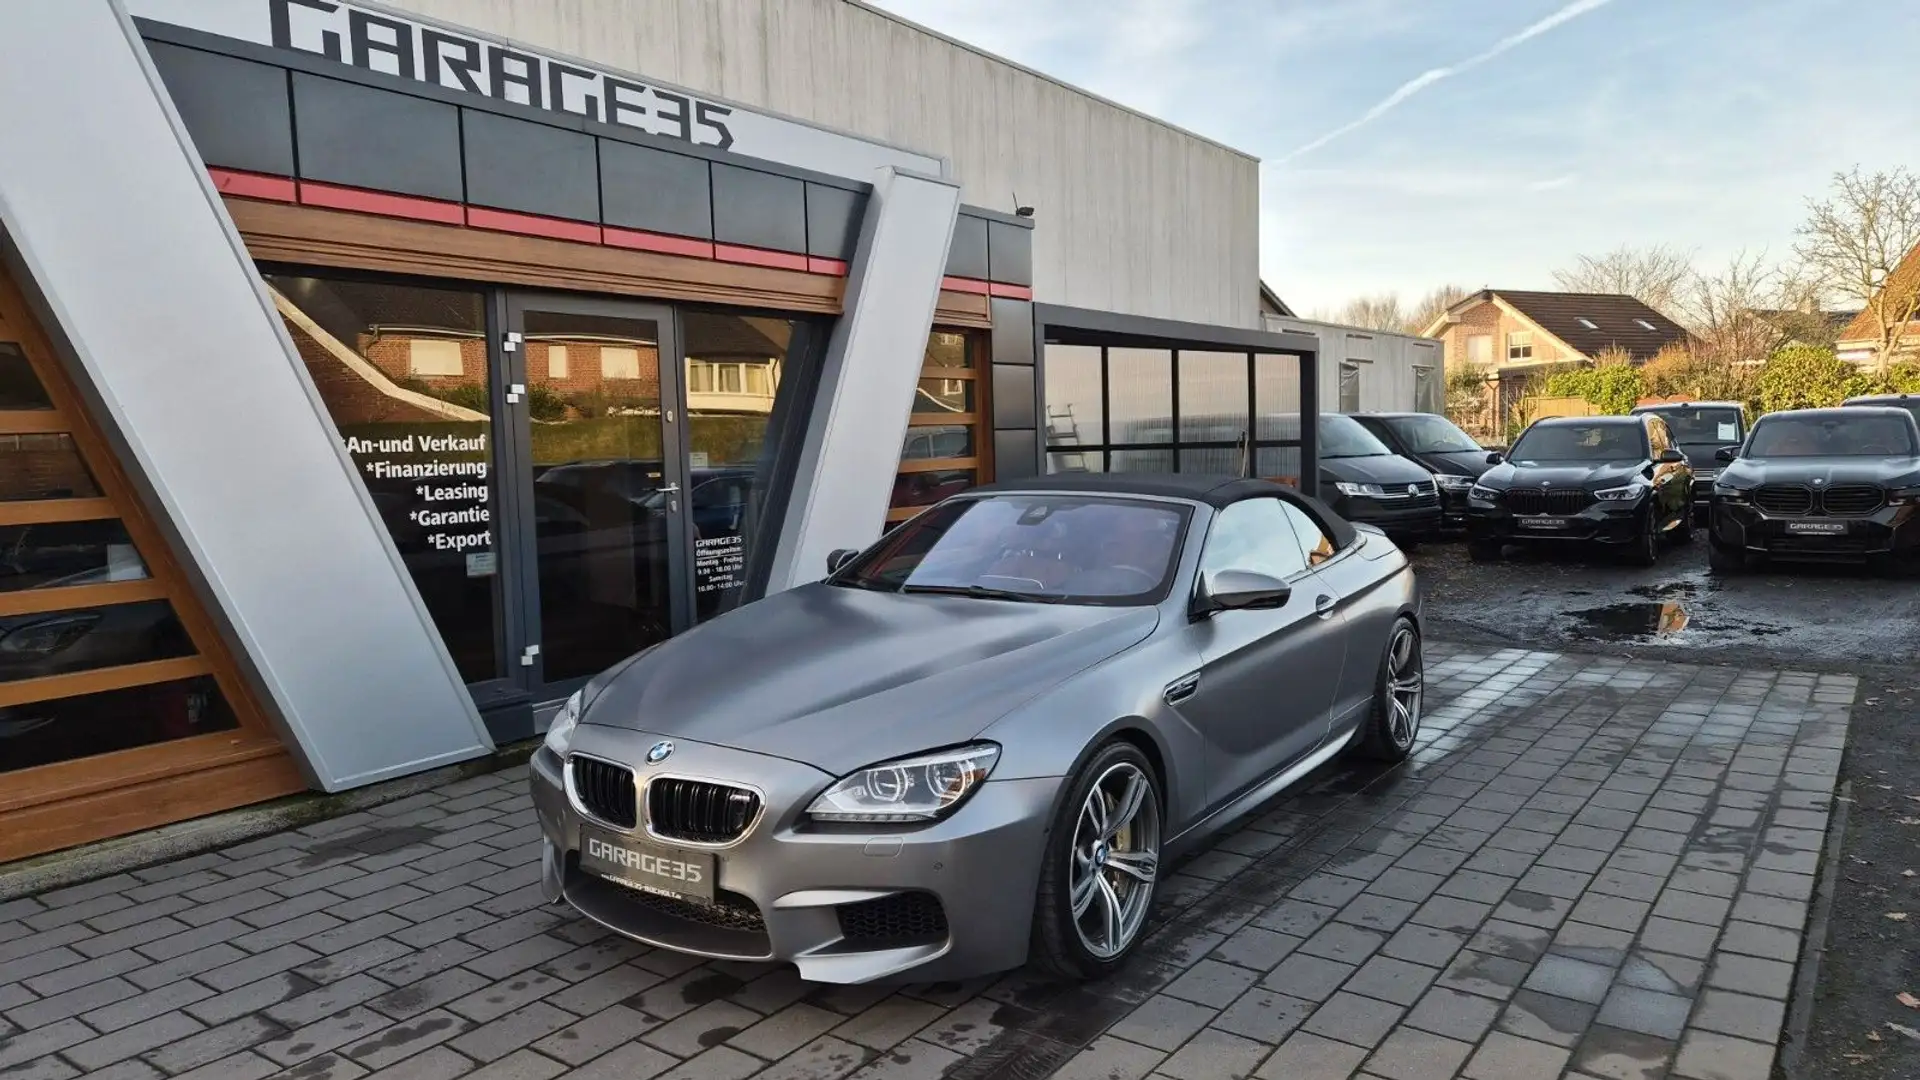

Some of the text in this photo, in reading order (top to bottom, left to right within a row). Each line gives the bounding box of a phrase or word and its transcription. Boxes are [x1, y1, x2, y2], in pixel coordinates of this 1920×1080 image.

[270, 0, 735, 152] GARAGE35
[418, 433, 486, 452] Verkauf
[695, 535, 742, 548] GARAGE35
[588, 837, 703, 883] GARAGE35
